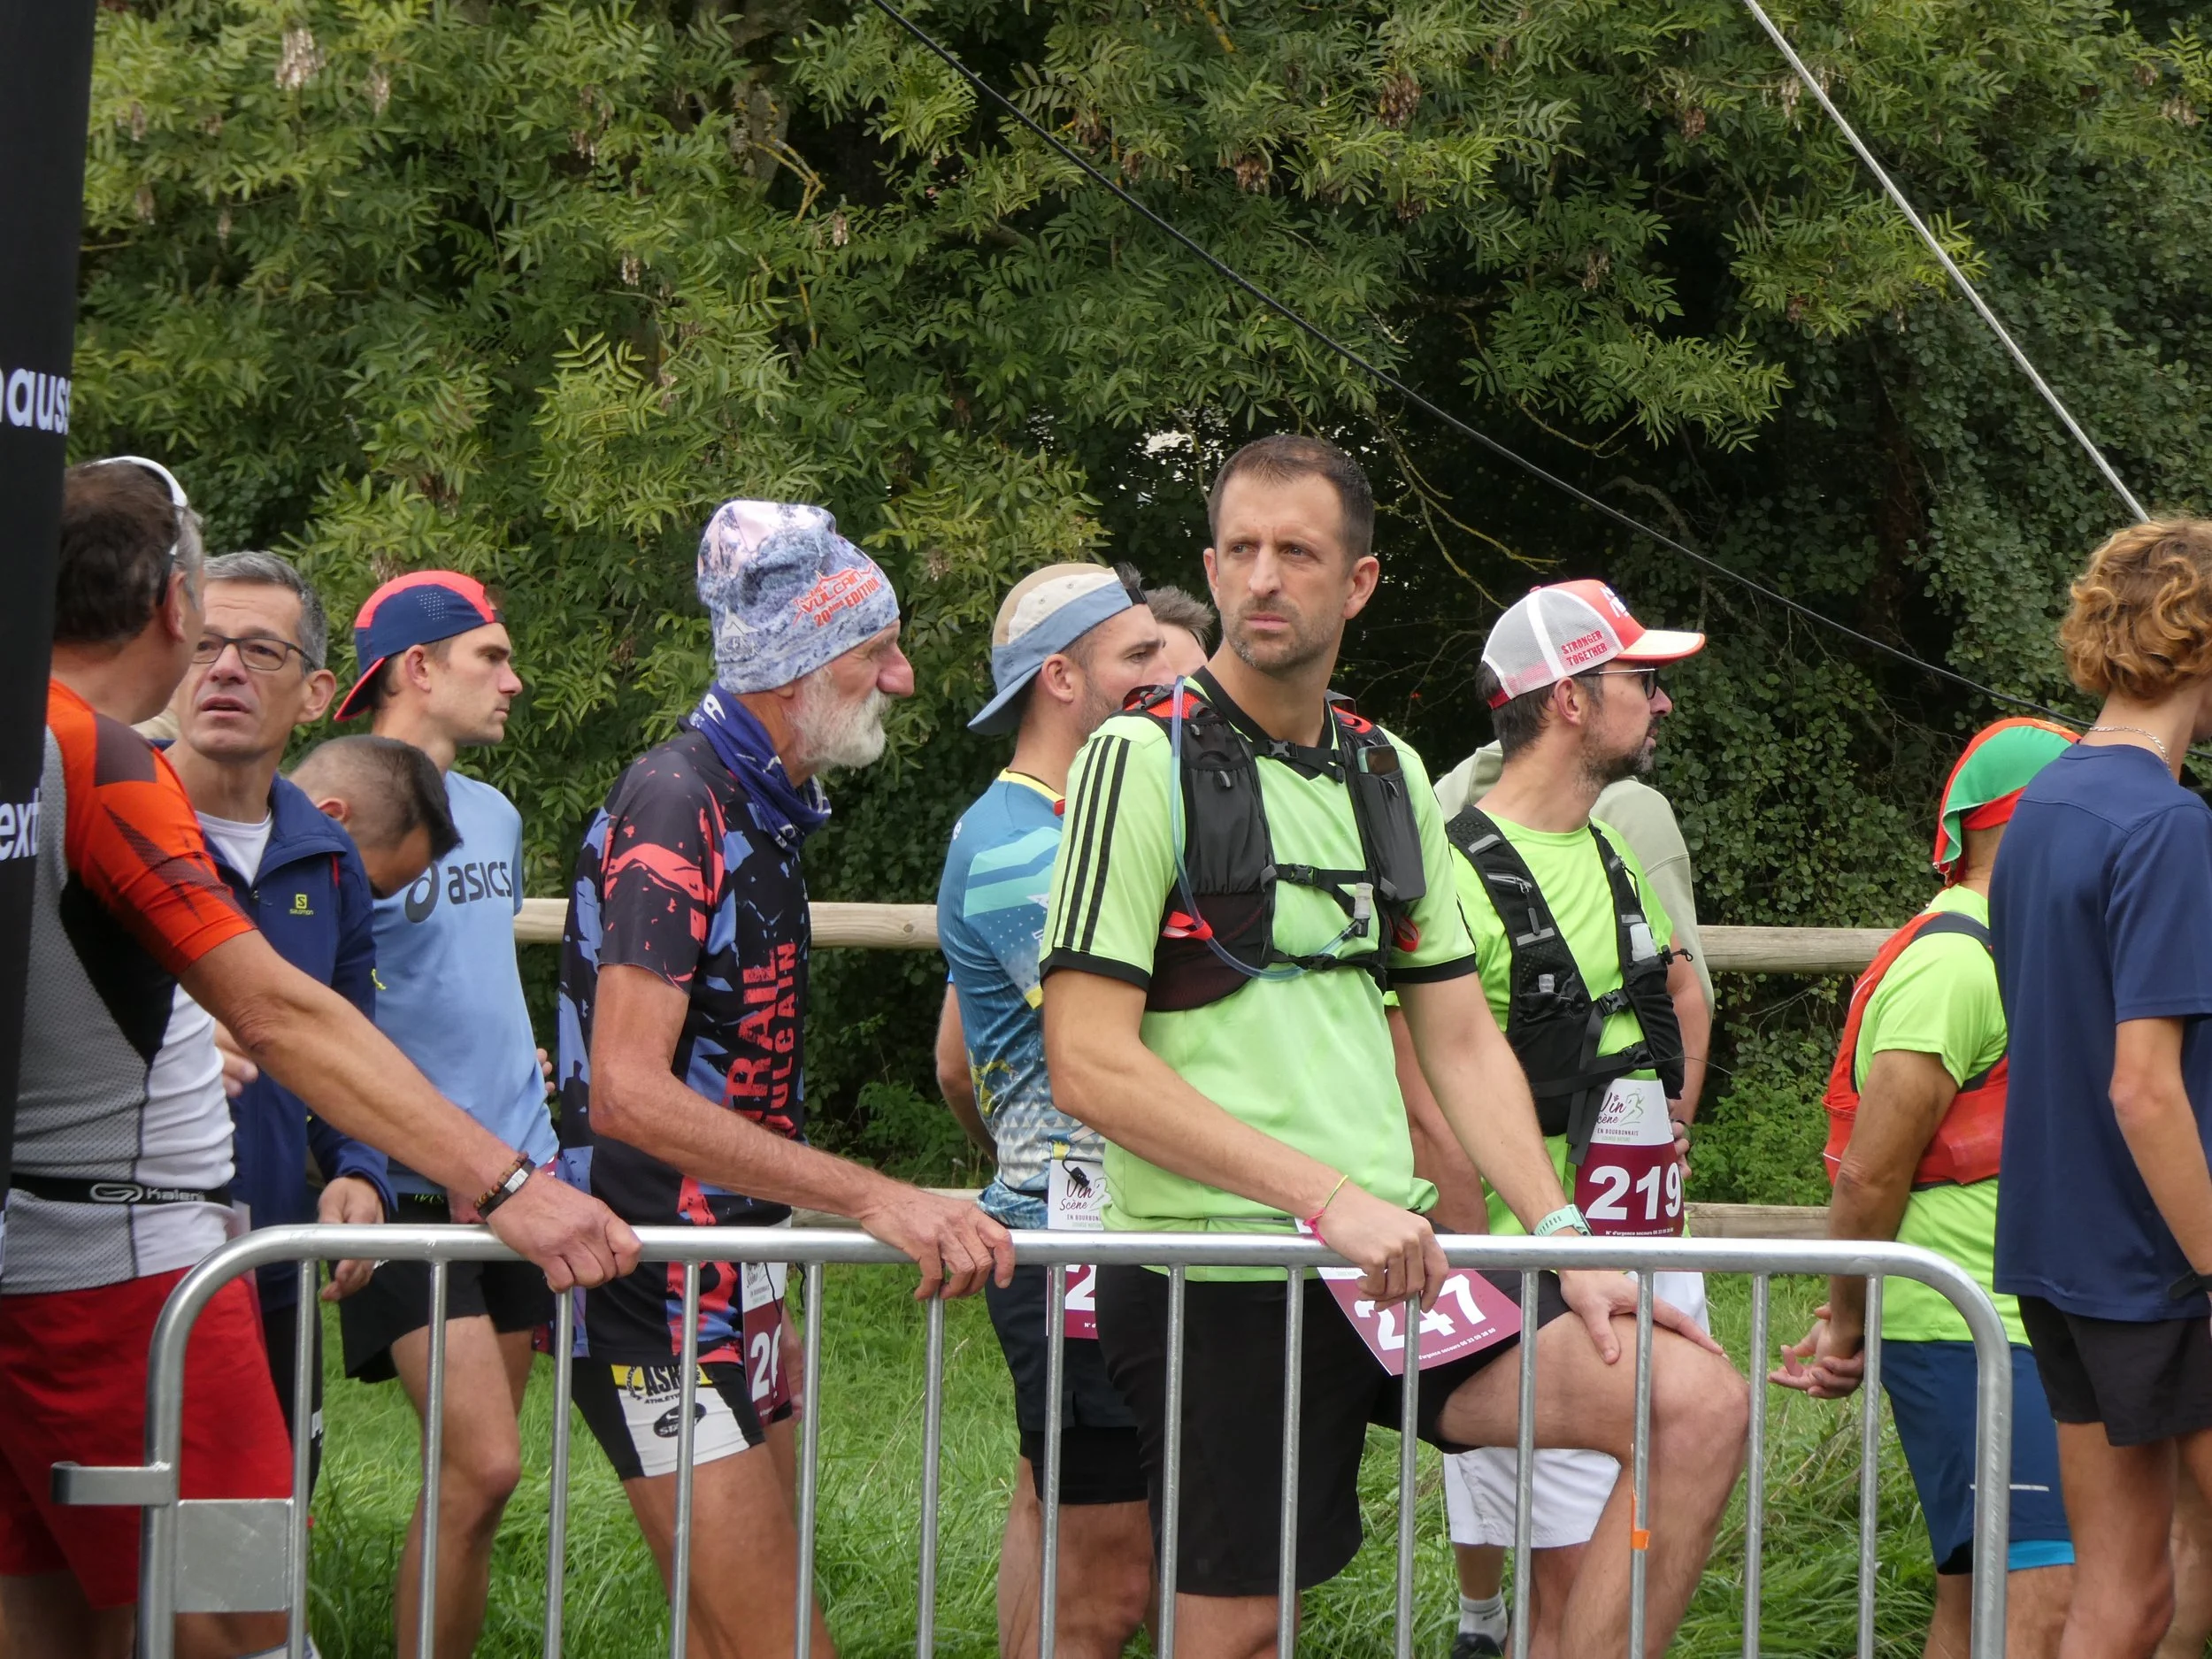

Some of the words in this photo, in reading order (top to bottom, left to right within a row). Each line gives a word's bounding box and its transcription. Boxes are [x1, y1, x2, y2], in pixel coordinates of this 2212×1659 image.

[845, 576, 880, 608] EDITION
[1561, 630, 1602, 655] STRONGER
[1566, 642, 1608, 666] TOGETHER
[1059, 1198, 1088, 1211] Scène
[1585, 1162, 1681, 1220] 219
[1354, 1274, 1486, 1351] 247
